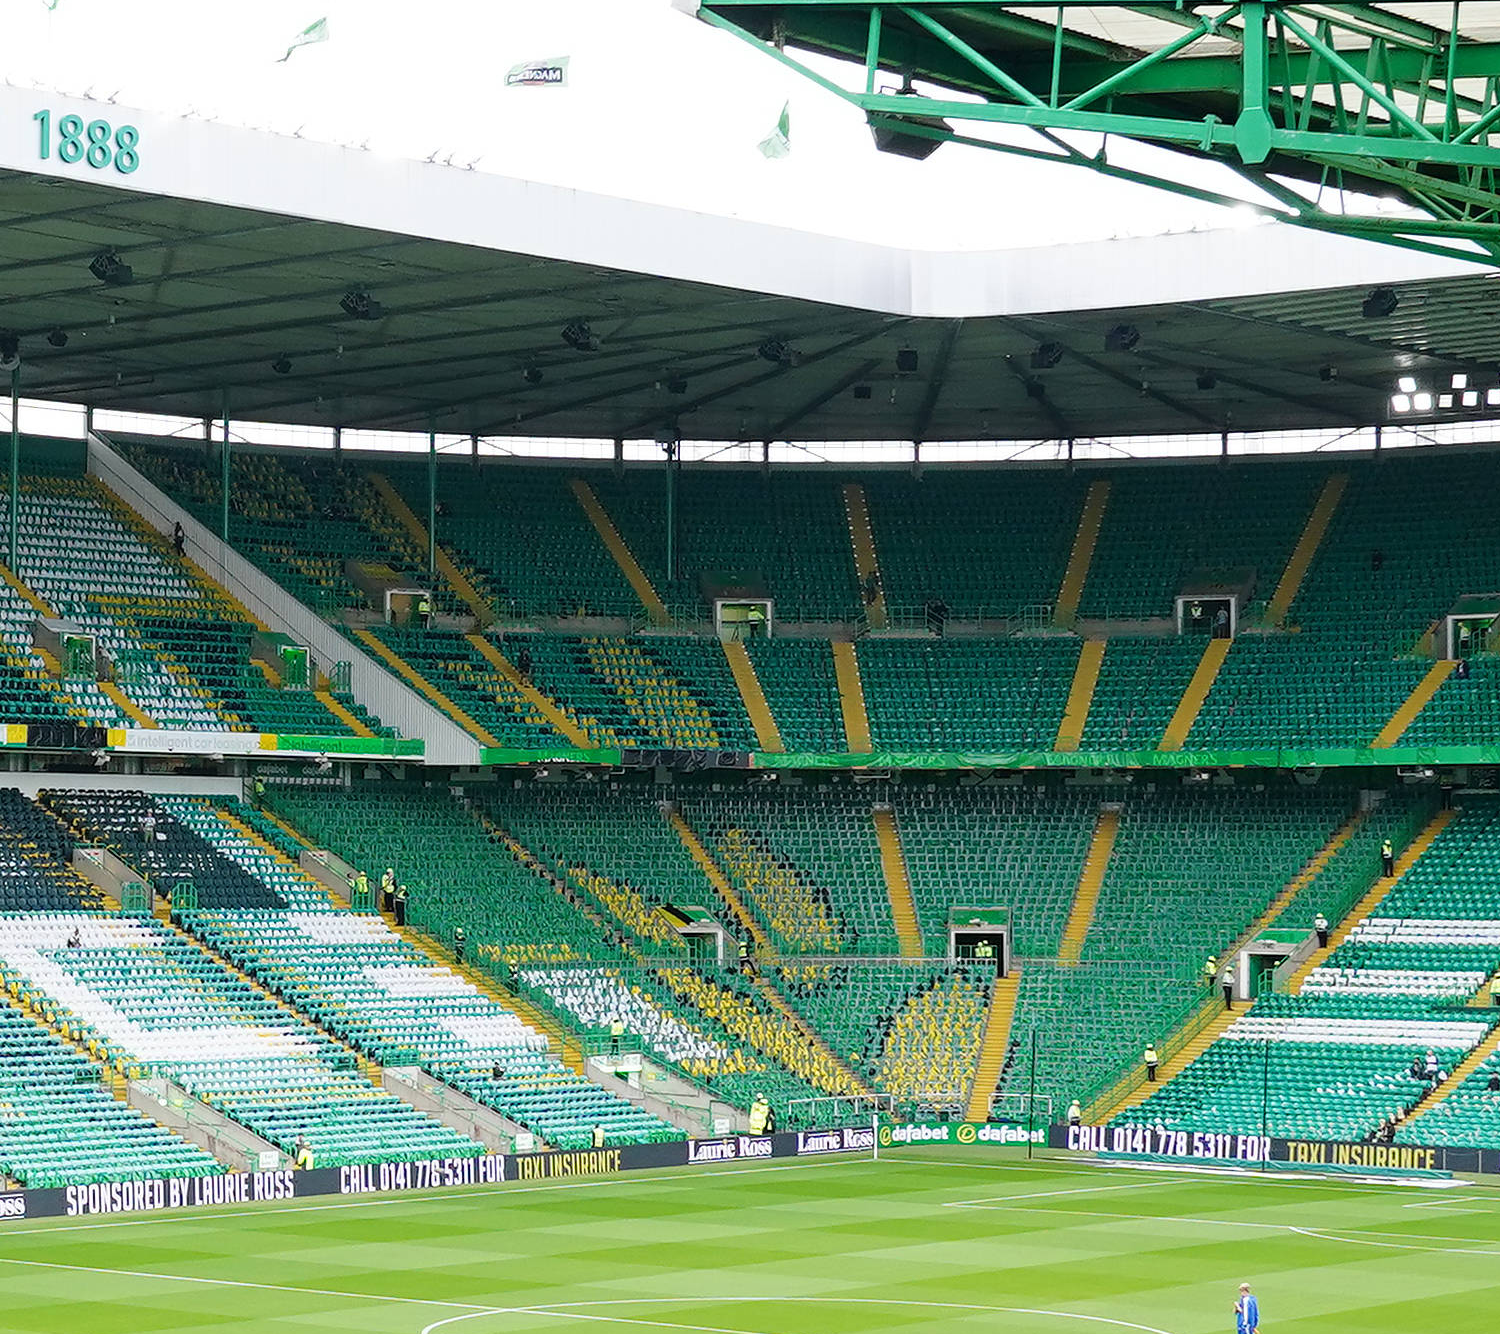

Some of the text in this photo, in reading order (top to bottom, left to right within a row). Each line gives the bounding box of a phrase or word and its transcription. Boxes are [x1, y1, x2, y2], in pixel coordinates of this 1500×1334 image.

[33, 108, 140, 174] 1888
[797, 1128, 873, 1153] Laurie Ross
[891, 1124, 949, 1142] dafabet
[976, 1124, 1045, 1143] dafabet
[1068, 1125, 1271, 1162] CALL 0141 778 5311 FOR
[689, 1136, 773, 1161] Laurie Ross
[1287, 1142, 1436, 1170] TAXI INSURANCE
[340, 1164, 376, 1194] CALL
[379, 1161, 412, 1190] 0141
[444, 1157, 475, 1186] 5311
[479, 1154, 505, 1182] FOR
[516, 1149, 621, 1180] TAXI INSURANCE
[66, 1171, 296, 1216] SPONSORED BY LAURIE ROSS
